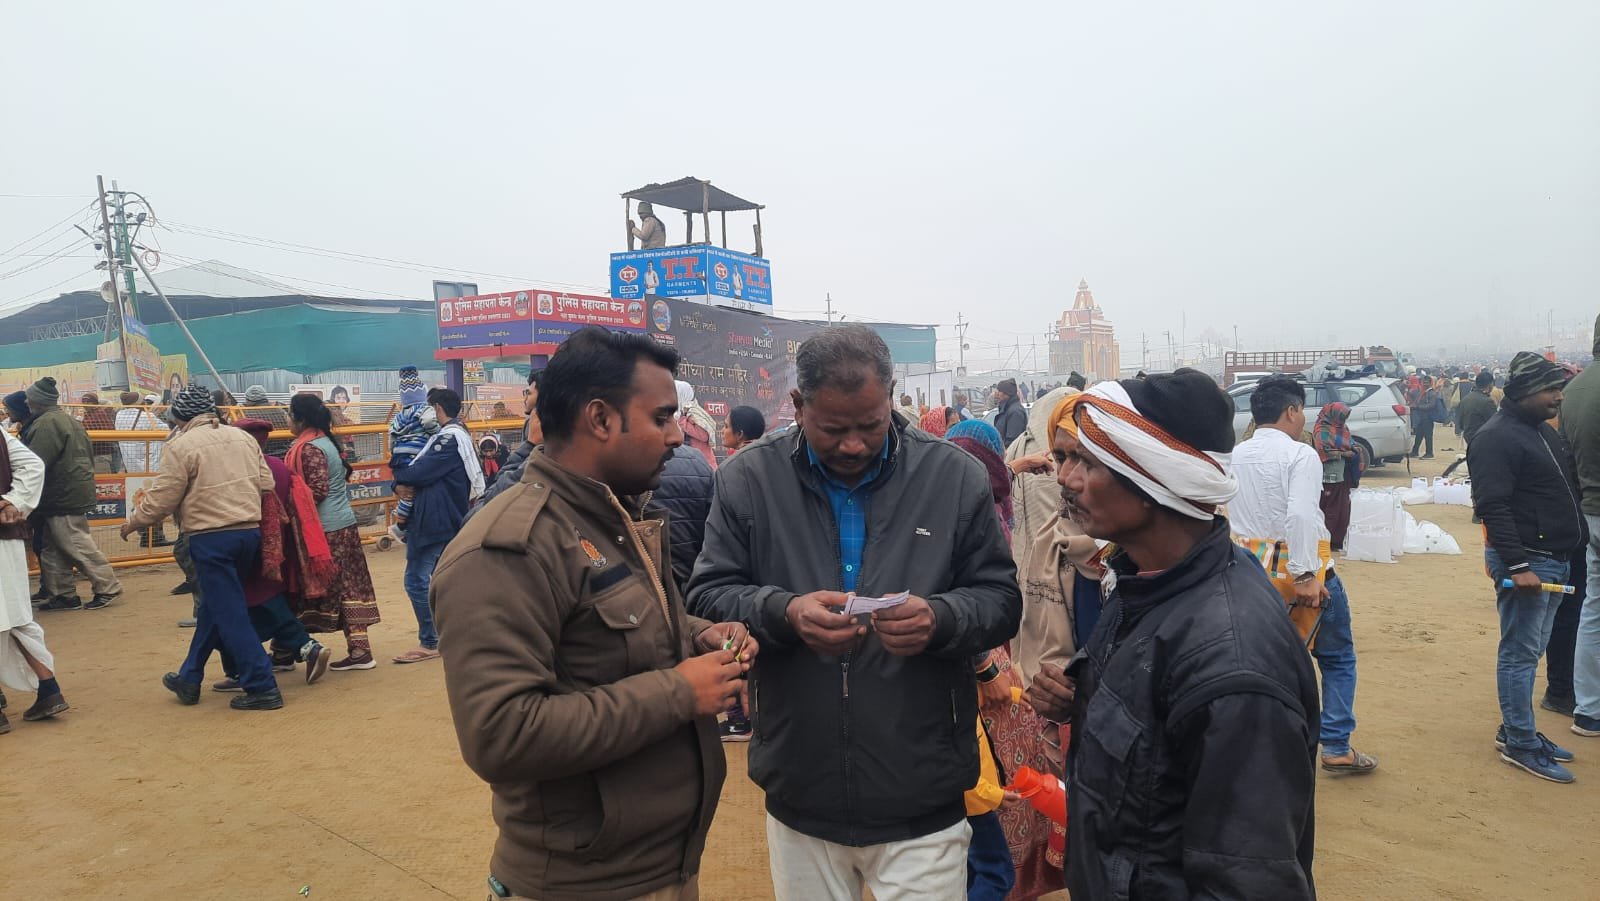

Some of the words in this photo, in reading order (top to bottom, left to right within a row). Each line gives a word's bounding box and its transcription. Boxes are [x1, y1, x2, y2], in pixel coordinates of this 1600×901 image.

[454, 297, 472, 316] पुलिस
[473, 299, 497, 311] सहायता
[556, 293, 579, 312] पुलिस
[580, 299, 609, 311] सहायता
[708, 366, 724, 380] राम
[707, 403, 725, 413] पता
